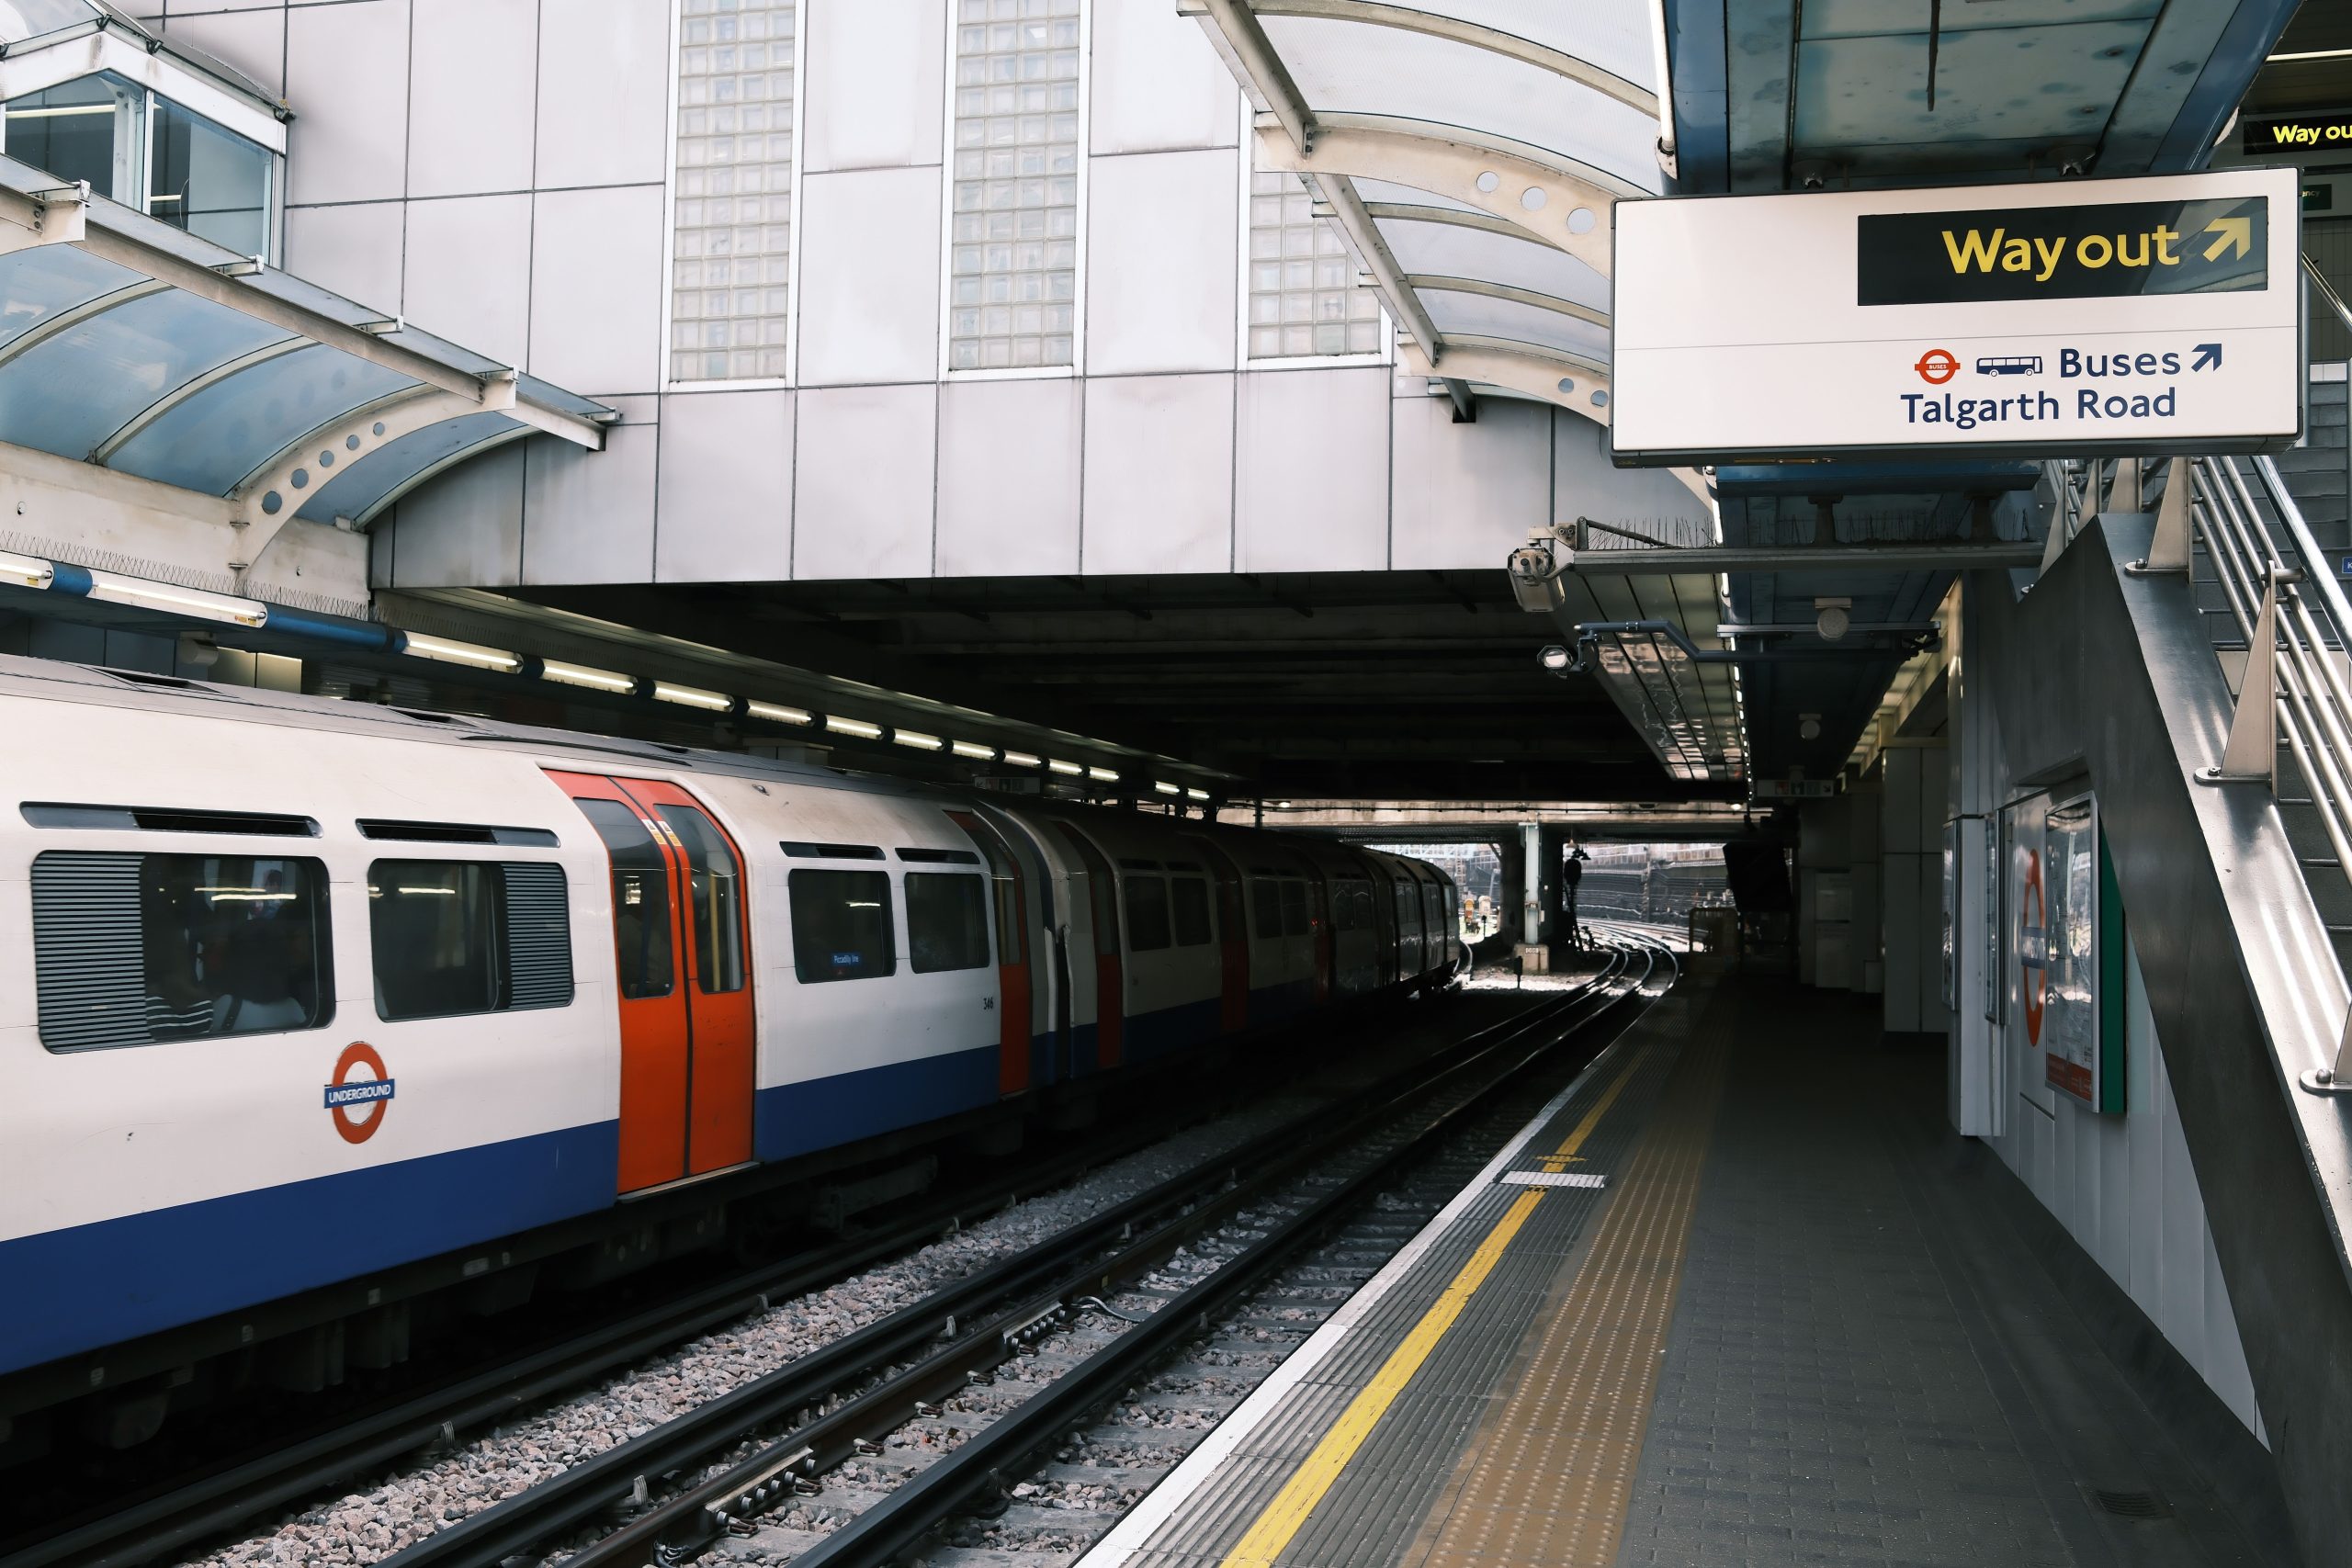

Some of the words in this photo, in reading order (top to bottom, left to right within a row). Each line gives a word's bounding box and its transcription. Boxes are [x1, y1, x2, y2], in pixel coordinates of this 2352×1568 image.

[2273, 125, 2322, 145] Way
[2325, 125, 2352, 140] ou
[1941, 229, 2066, 282] Way
[2076, 224, 2180, 269] out
[2060, 349, 2181, 378] Buses
[1900, 391, 2060, 430] Talgarth
[2077, 387, 2176, 419] Road
[328, 1084, 391, 1103] UNDERGROUND
